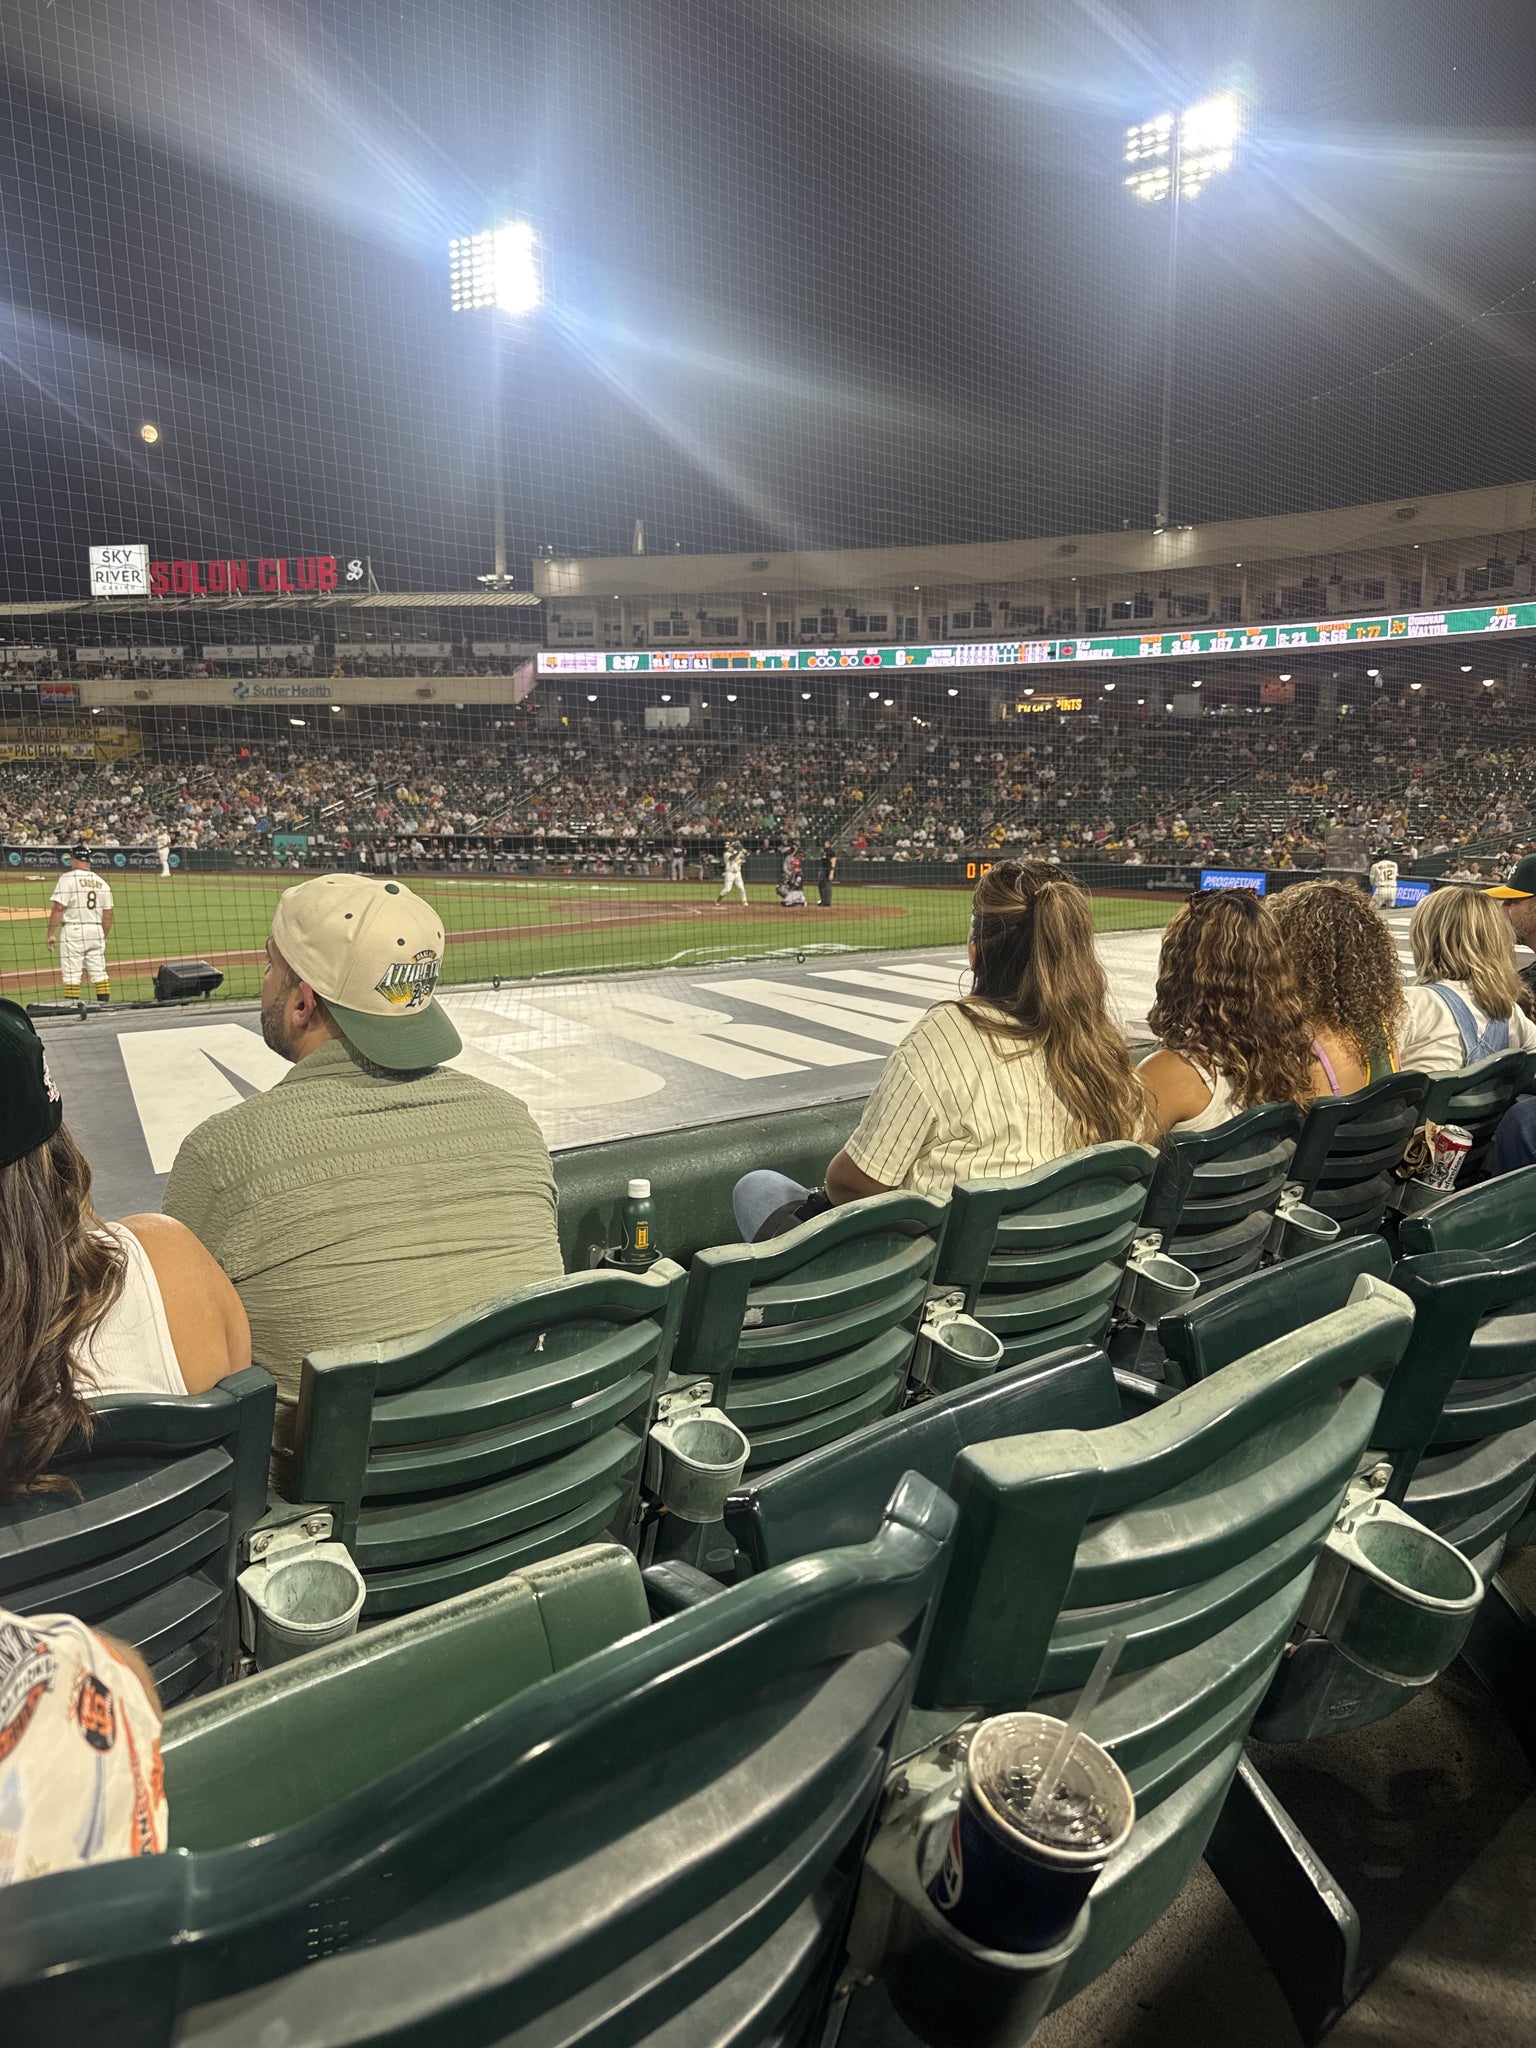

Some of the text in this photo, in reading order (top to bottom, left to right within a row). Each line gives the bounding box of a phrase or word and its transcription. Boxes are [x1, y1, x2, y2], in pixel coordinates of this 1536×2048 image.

[102, 550, 132, 564] SKY
[95, 570, 142, 583] RIVER
[150, 555, 338, 596] SOLON CLUB
[1484, 613, 1517, 631] .275
[1408, 624, 1448, 637] WALTON
[1240, 634, 1268, 650] 1.27
[1291, 632, 1307, 644] 21
[253, 684, 331, 697] Sutter Health
[17, 726, 62, 740] PACIFICO
[15, 744, 62, 757] PACIFICO
[966, 862, 976, 879] 0
[1382, 869, 1393, 881] 12
[79, 878, 103, 890] CROSBY
[1203, 876, 1264, 889] PROGRESSIVE
[86, 891, 97, 910] 8
